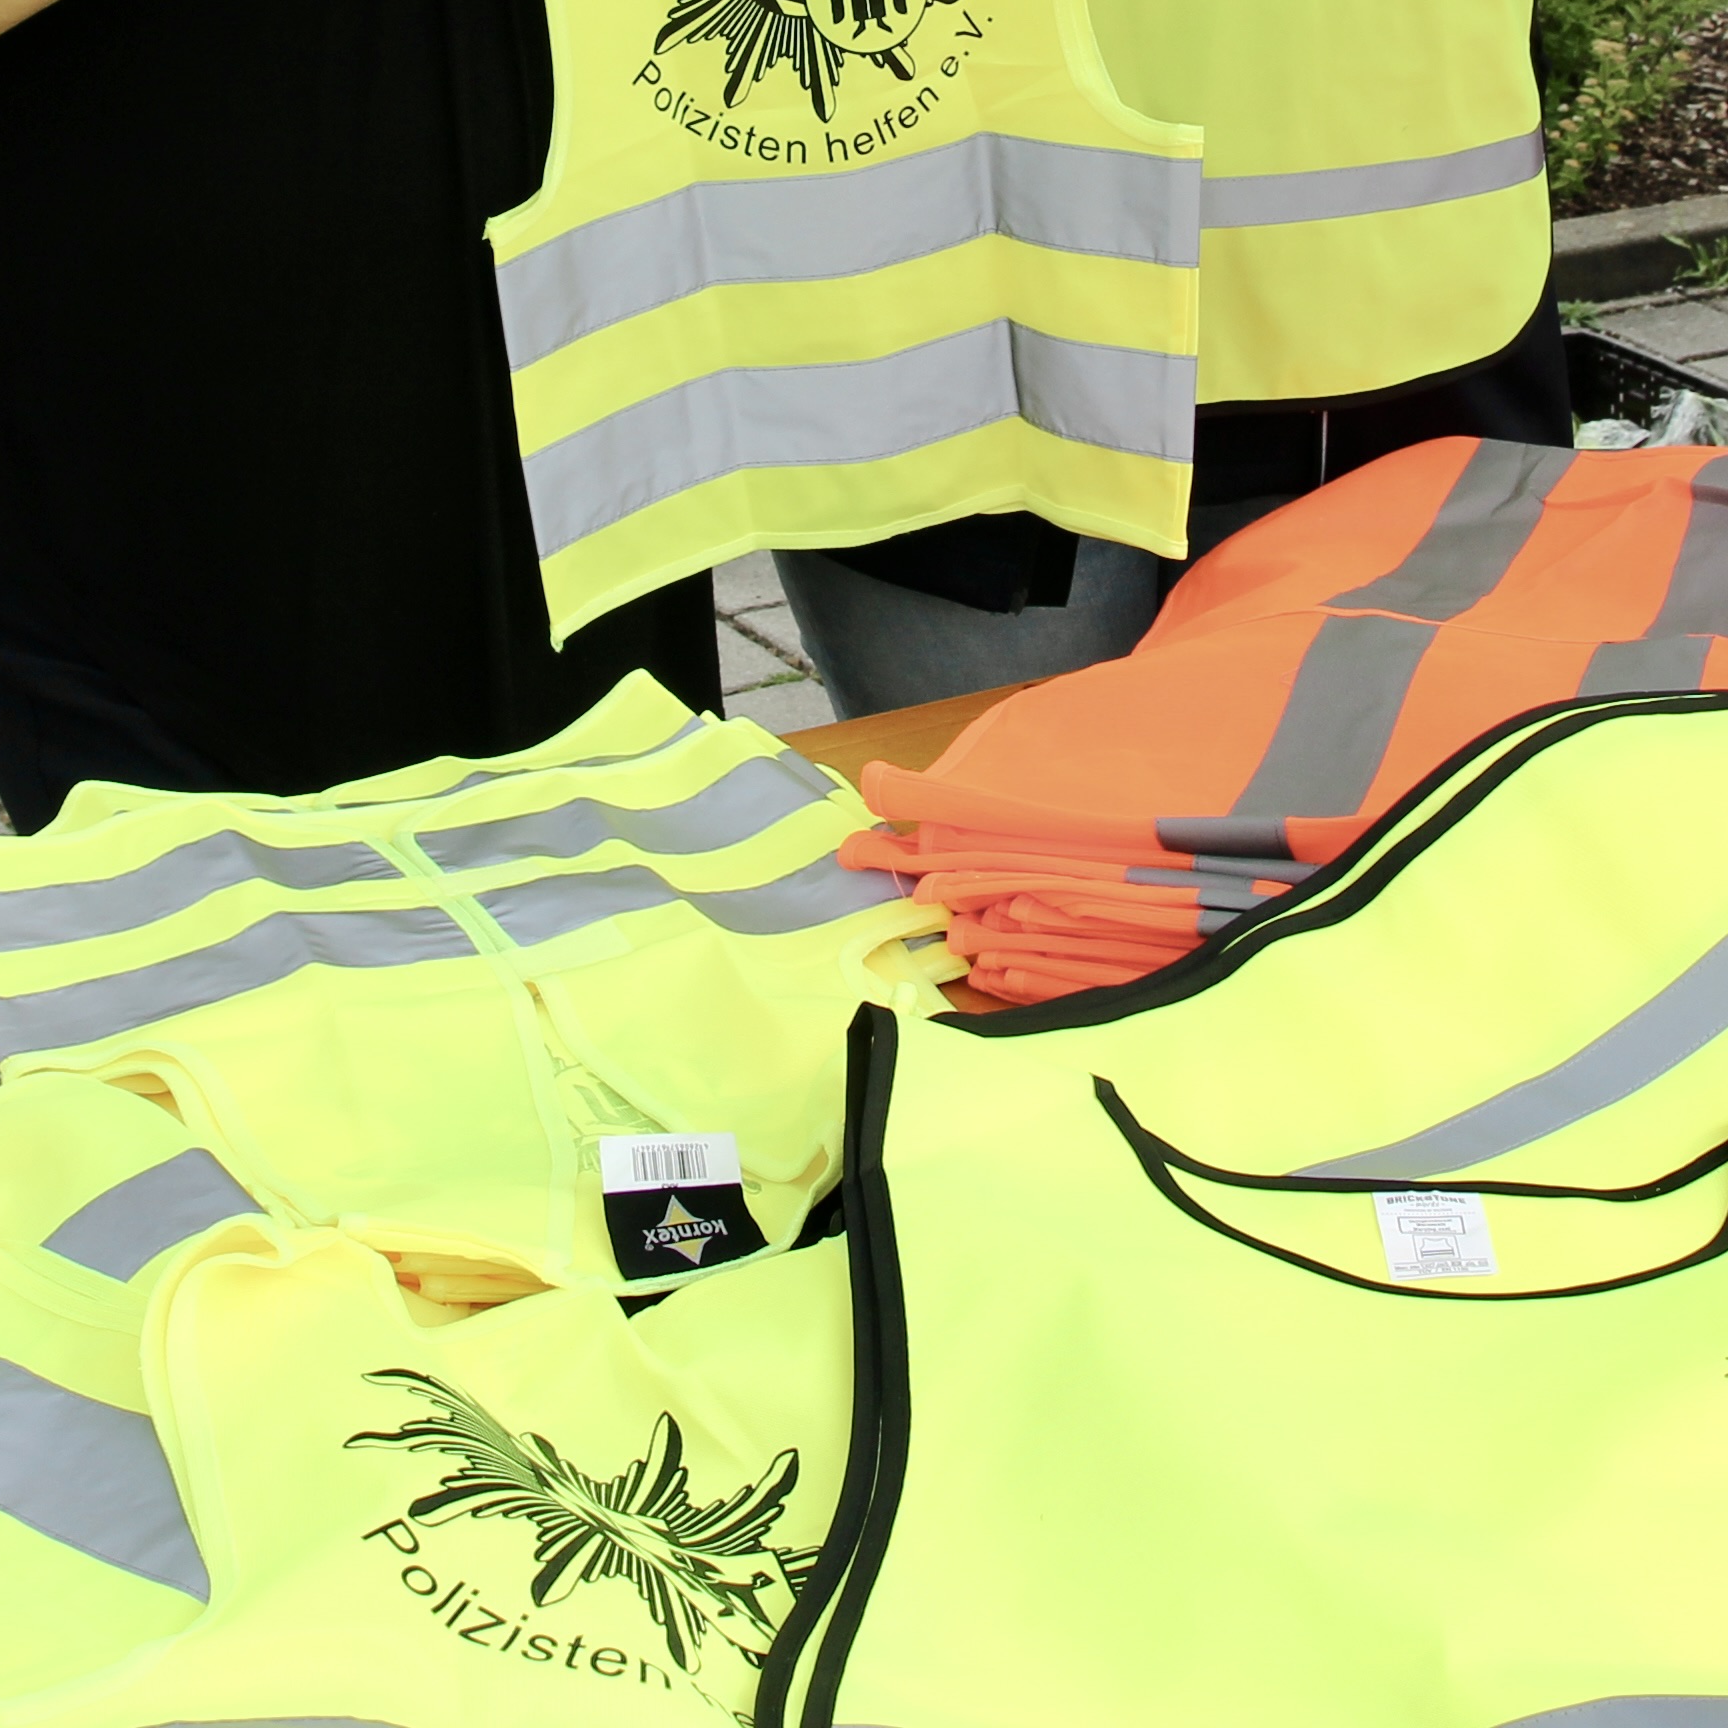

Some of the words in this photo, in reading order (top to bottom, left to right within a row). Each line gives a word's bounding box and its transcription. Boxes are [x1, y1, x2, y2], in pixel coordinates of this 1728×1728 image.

[632, 59, 808, 165] Polizisten
[826, 84, 941, 164] helfen
[939, 9, 994, 79] e.V.
[642, 1219, 728, 1245] korntex
[361, 1518, 672, 1691] Polizisten
